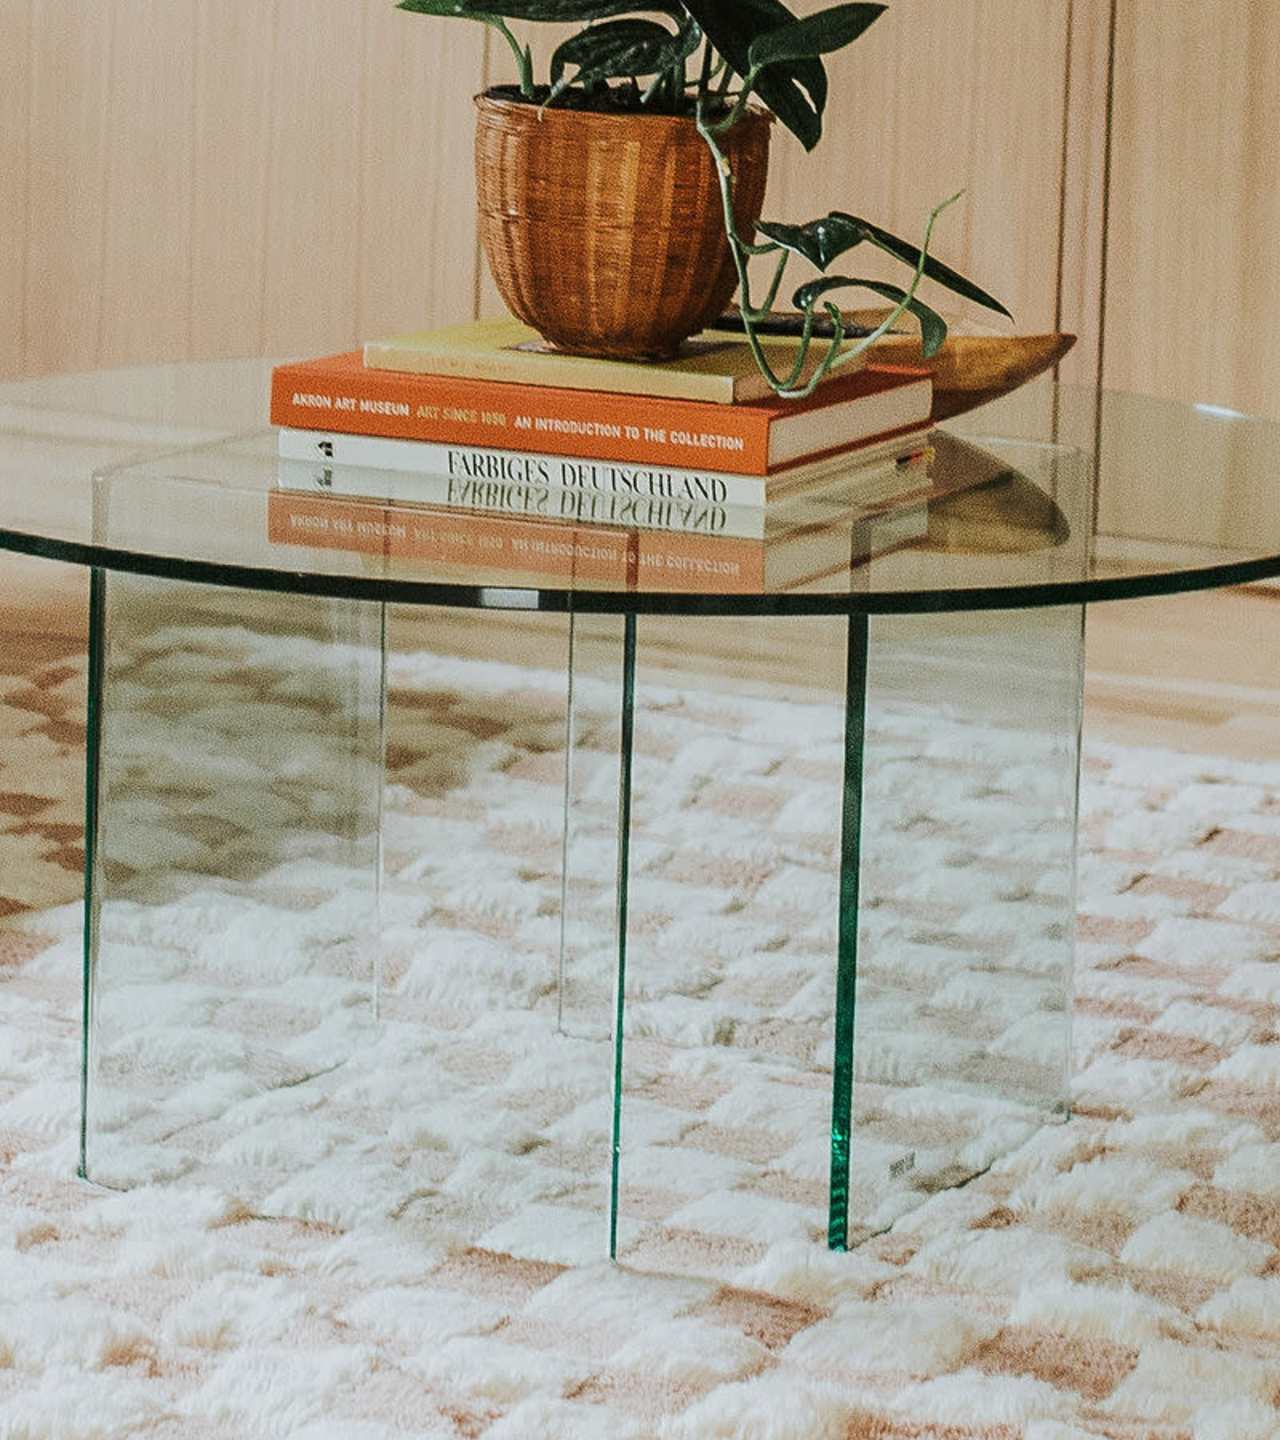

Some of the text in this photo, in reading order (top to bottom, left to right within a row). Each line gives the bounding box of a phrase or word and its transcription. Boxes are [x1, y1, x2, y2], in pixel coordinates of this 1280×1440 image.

[292, 392, 331, 409] AKRON
[335, 397, 357, 412] ART
[360, 400, 411, 417] MUSEUM
[417, 405, 440, 419] ART
[443, 408, 478, 424] SINCE
[513, 415, 531, 431] AN
[535, 417, 621, 438] INTRODUCTION
[624, 425, 640, 441] TO
[644, 427, 666, 443] THE
[670, 430, 744, 451] COLLECTION
[447, 450, 727, 503] FARBIGES DEUTSCHLAND
